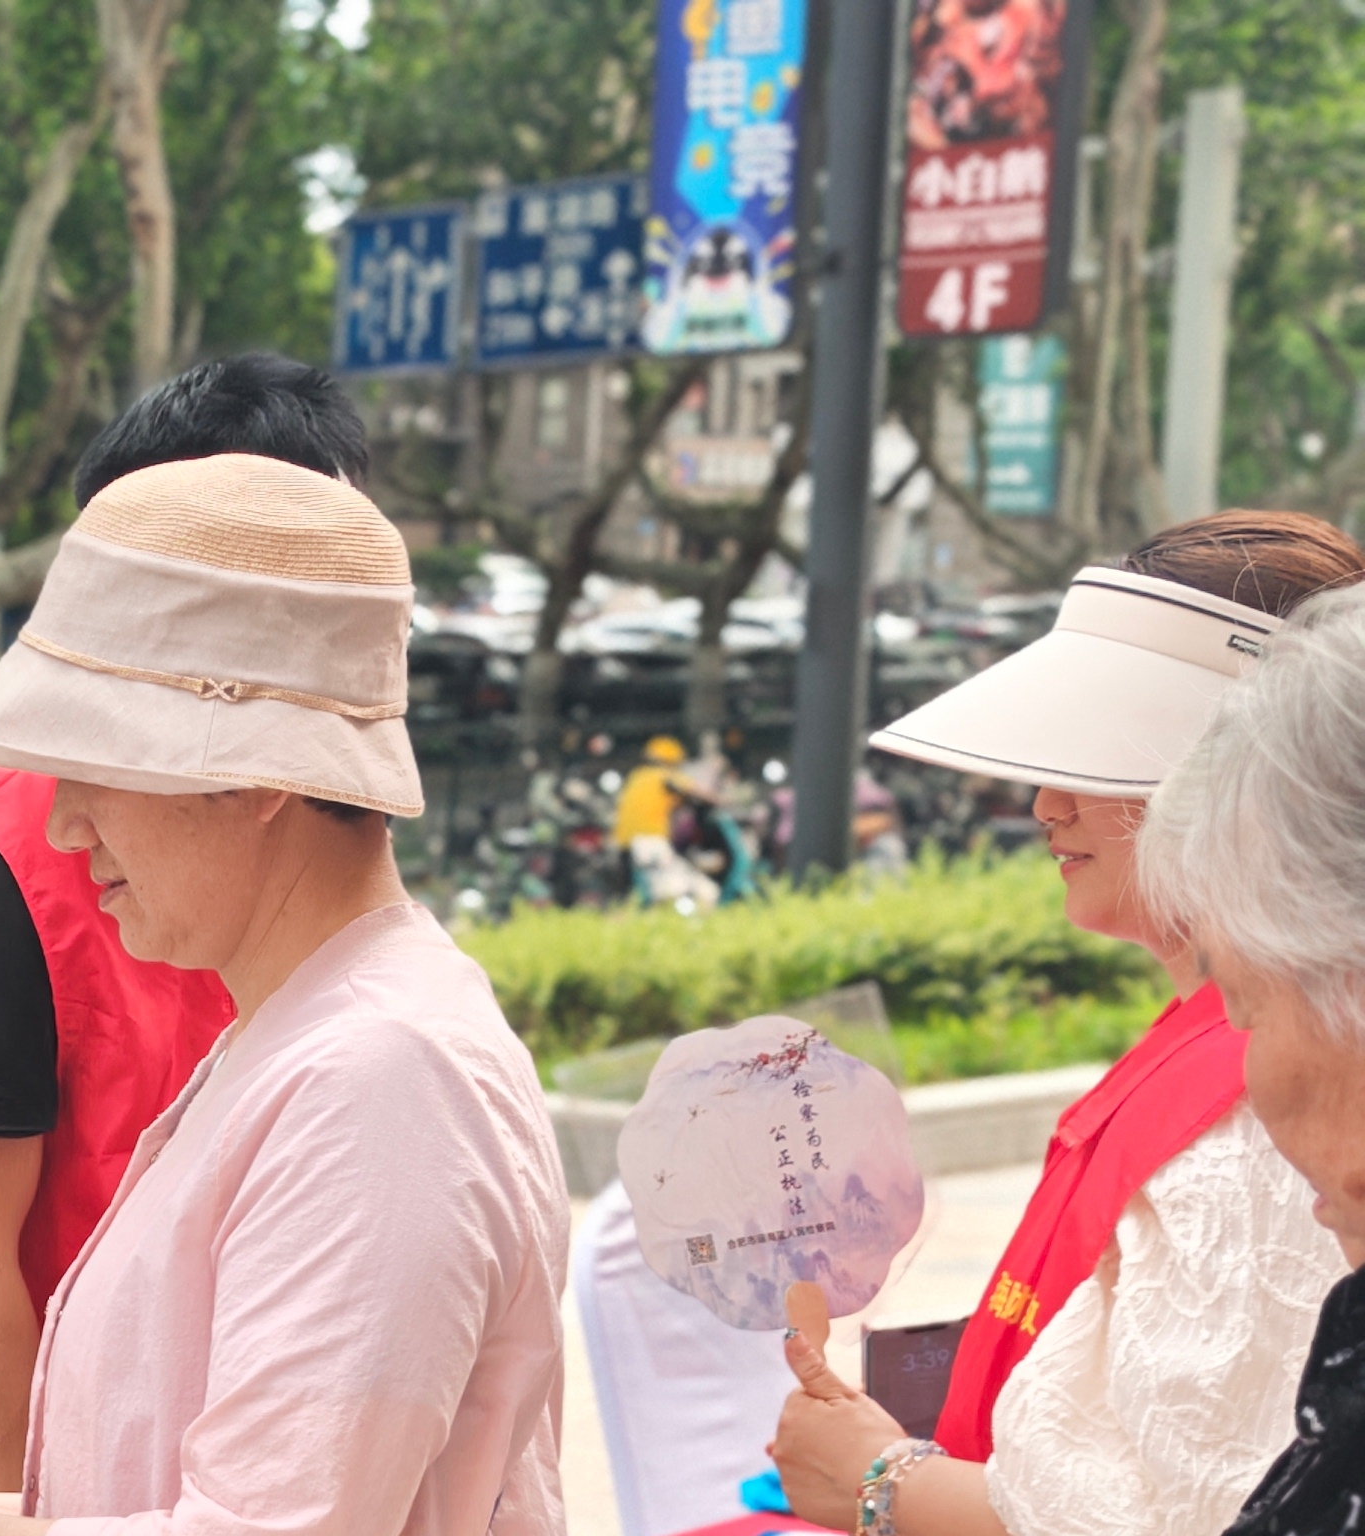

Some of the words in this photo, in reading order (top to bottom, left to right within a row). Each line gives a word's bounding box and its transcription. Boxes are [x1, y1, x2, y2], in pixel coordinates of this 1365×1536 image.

[924, 261, 1011, 333] 4F
[769, 1124, 806, 1216] 公正执法
[792, 1079, 830, 1171] 检察为民
